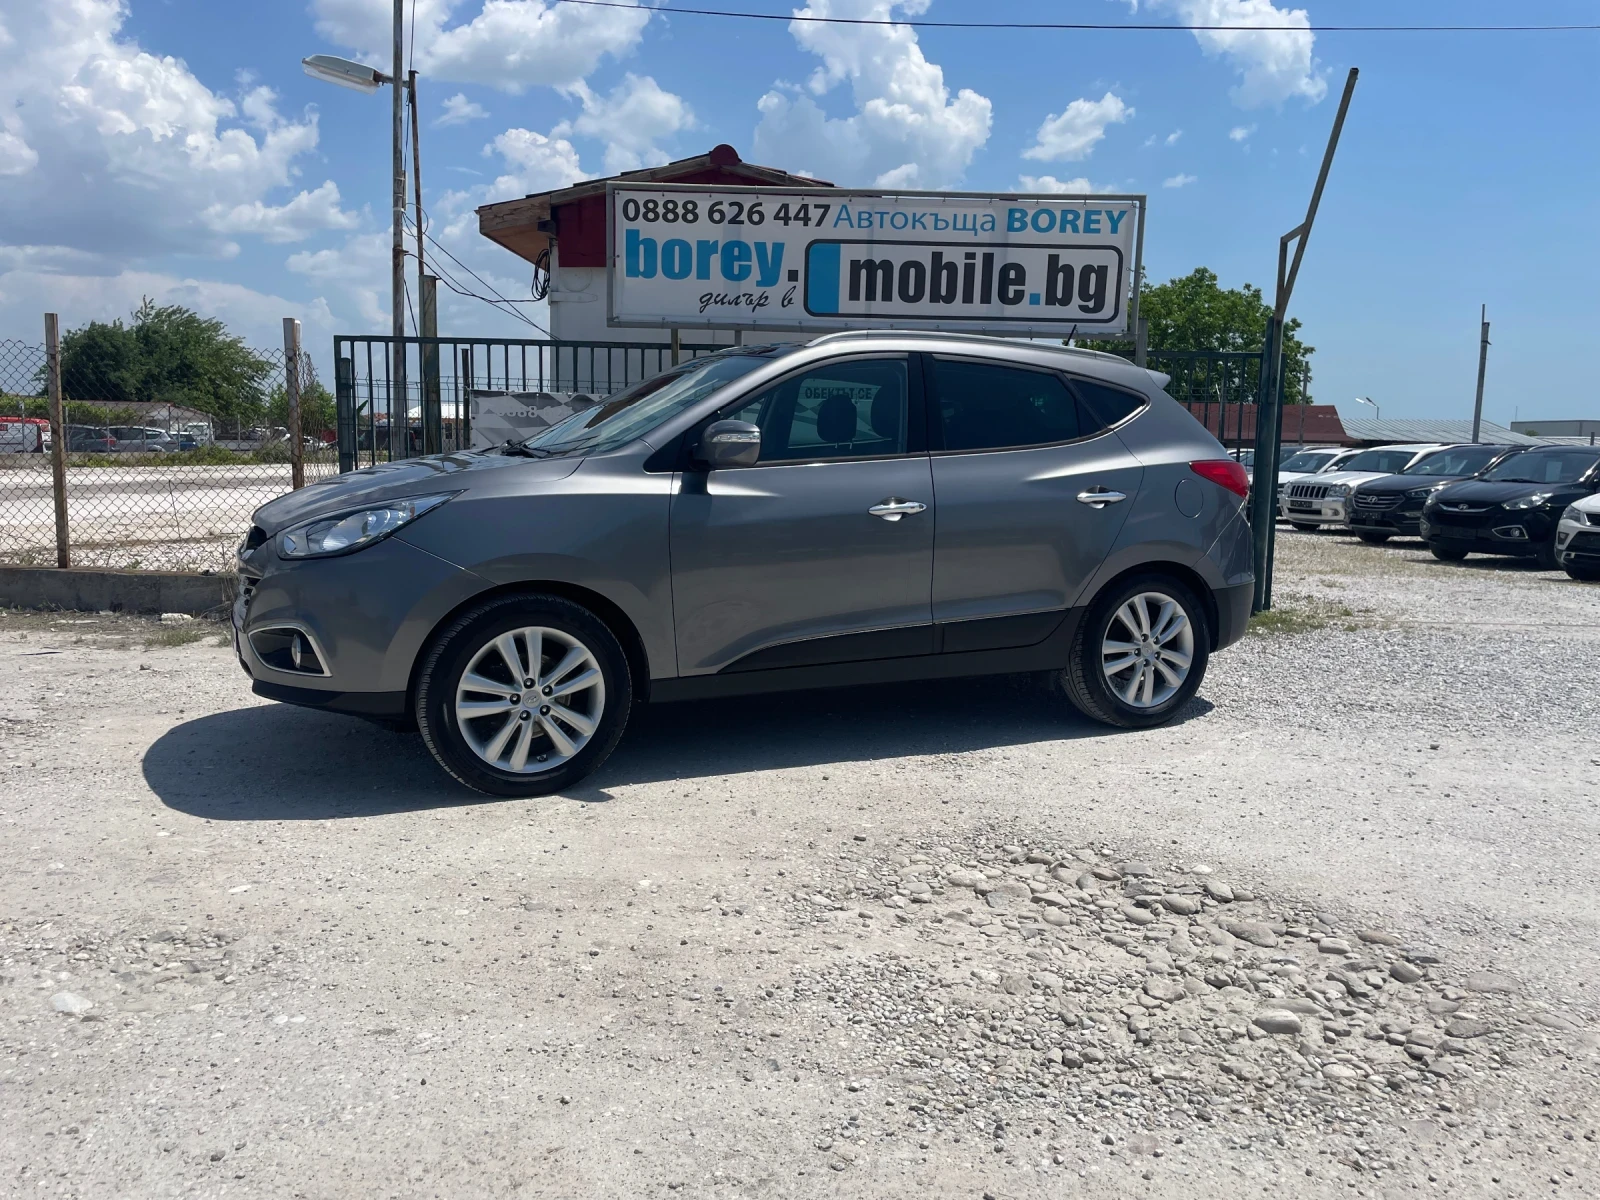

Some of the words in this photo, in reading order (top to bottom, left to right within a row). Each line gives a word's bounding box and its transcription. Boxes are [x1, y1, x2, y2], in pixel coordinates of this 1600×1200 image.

[622, 198, 700, 224] 0888
[707, 200, 765, 226] 626
[773, 203, 831, 228] 447
[833, 204, 996, 236] Автокъща
[1007, 208, 1128, 234] BOREY
[849, 251, 1109, 314] mobile.bg
[699, 290, 770, 313] дилър
